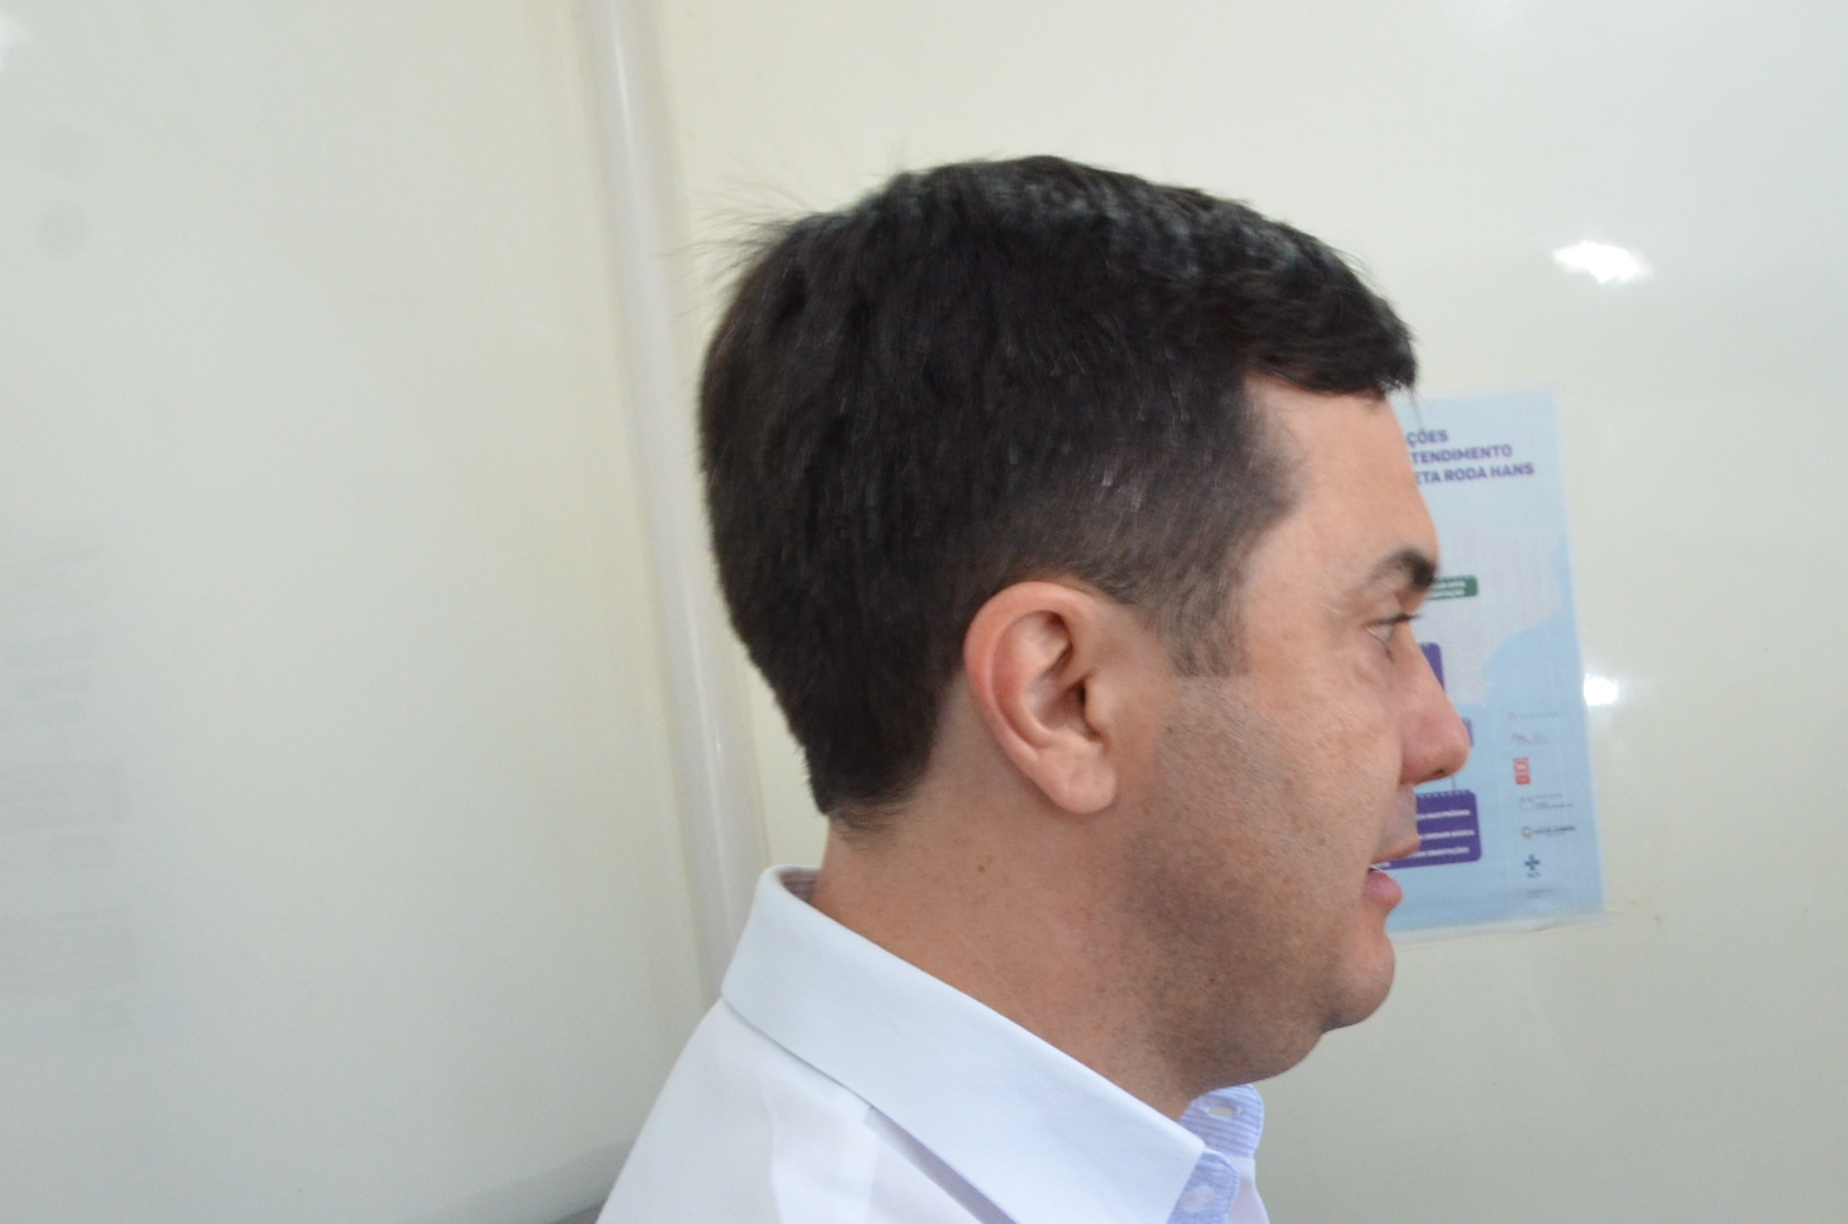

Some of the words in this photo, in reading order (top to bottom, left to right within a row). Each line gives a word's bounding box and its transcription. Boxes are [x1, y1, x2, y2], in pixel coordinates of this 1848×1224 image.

[1406, 427, 1448, 449] ÇÕES
[1411, 444, 1512, 464] TENDIMENTO
[1415, 470, 1441, 485] ETA
[1444, 466, 1487, 481] RODA
[1490, 462, 1534, 478] HANS
